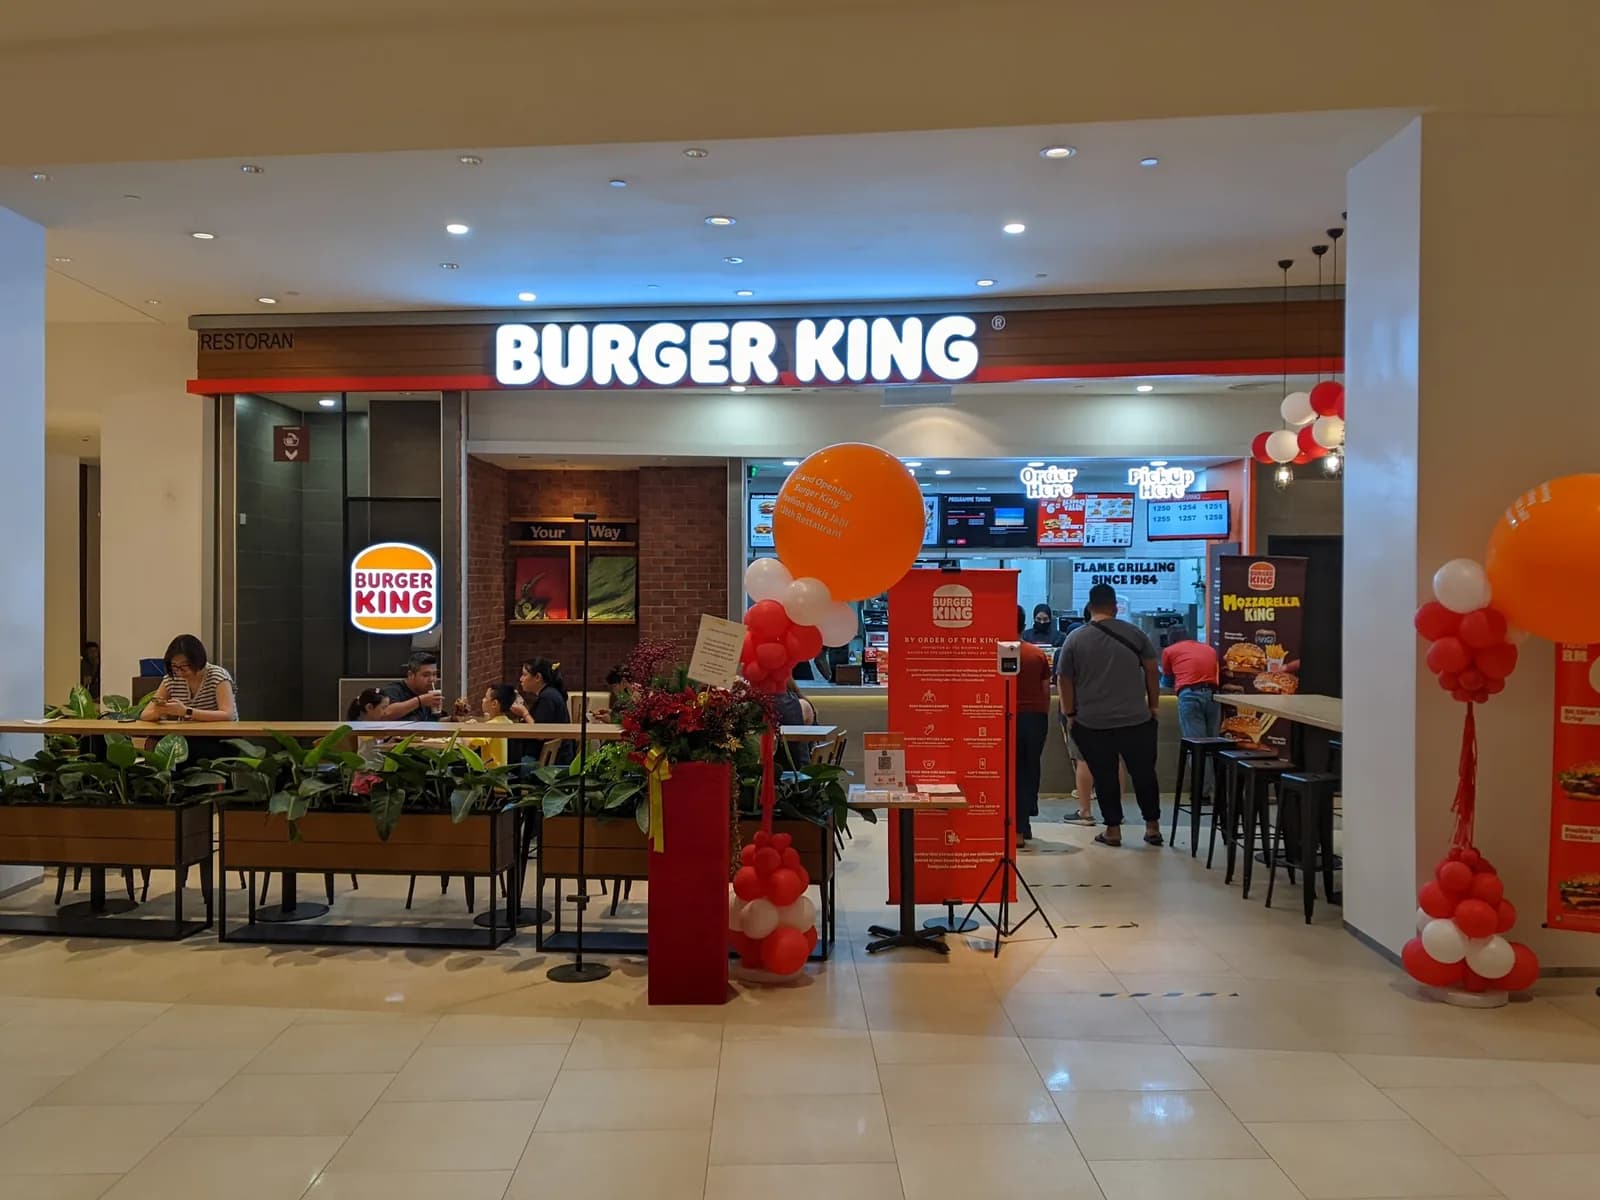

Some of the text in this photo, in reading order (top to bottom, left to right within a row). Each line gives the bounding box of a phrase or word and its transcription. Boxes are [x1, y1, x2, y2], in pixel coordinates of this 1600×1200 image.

[200, 332, 294, 351] RESTORAN
[495, 320, 779, 386] BURGER
[795, 315, 980, 383] KING
[1020, 465, 1078, 484] Order
[815, 478, 853, 501] Opening
[1026, 483, 1073, 499] Here
[1139, 483, 1185, 499] Here
[819, 492, 840, 509] King
[1153, 504, 1171, 512] 1250
[530, 525, 621, 540] Your Way
[1074, 562, 1175, 573] FLAME GRILLING
[355, 572, 433, 589] BURGER
[1092, 574, 1158, 585] SINCE 1954
[1250, 576, 1273, 584] KING
[355, 590, 433, 614] KING
[933, 597, 973, 607] BURGER
[1222, 594, 1300, 612] MOZZARELLA
[933, 607, 973, 620] KING
